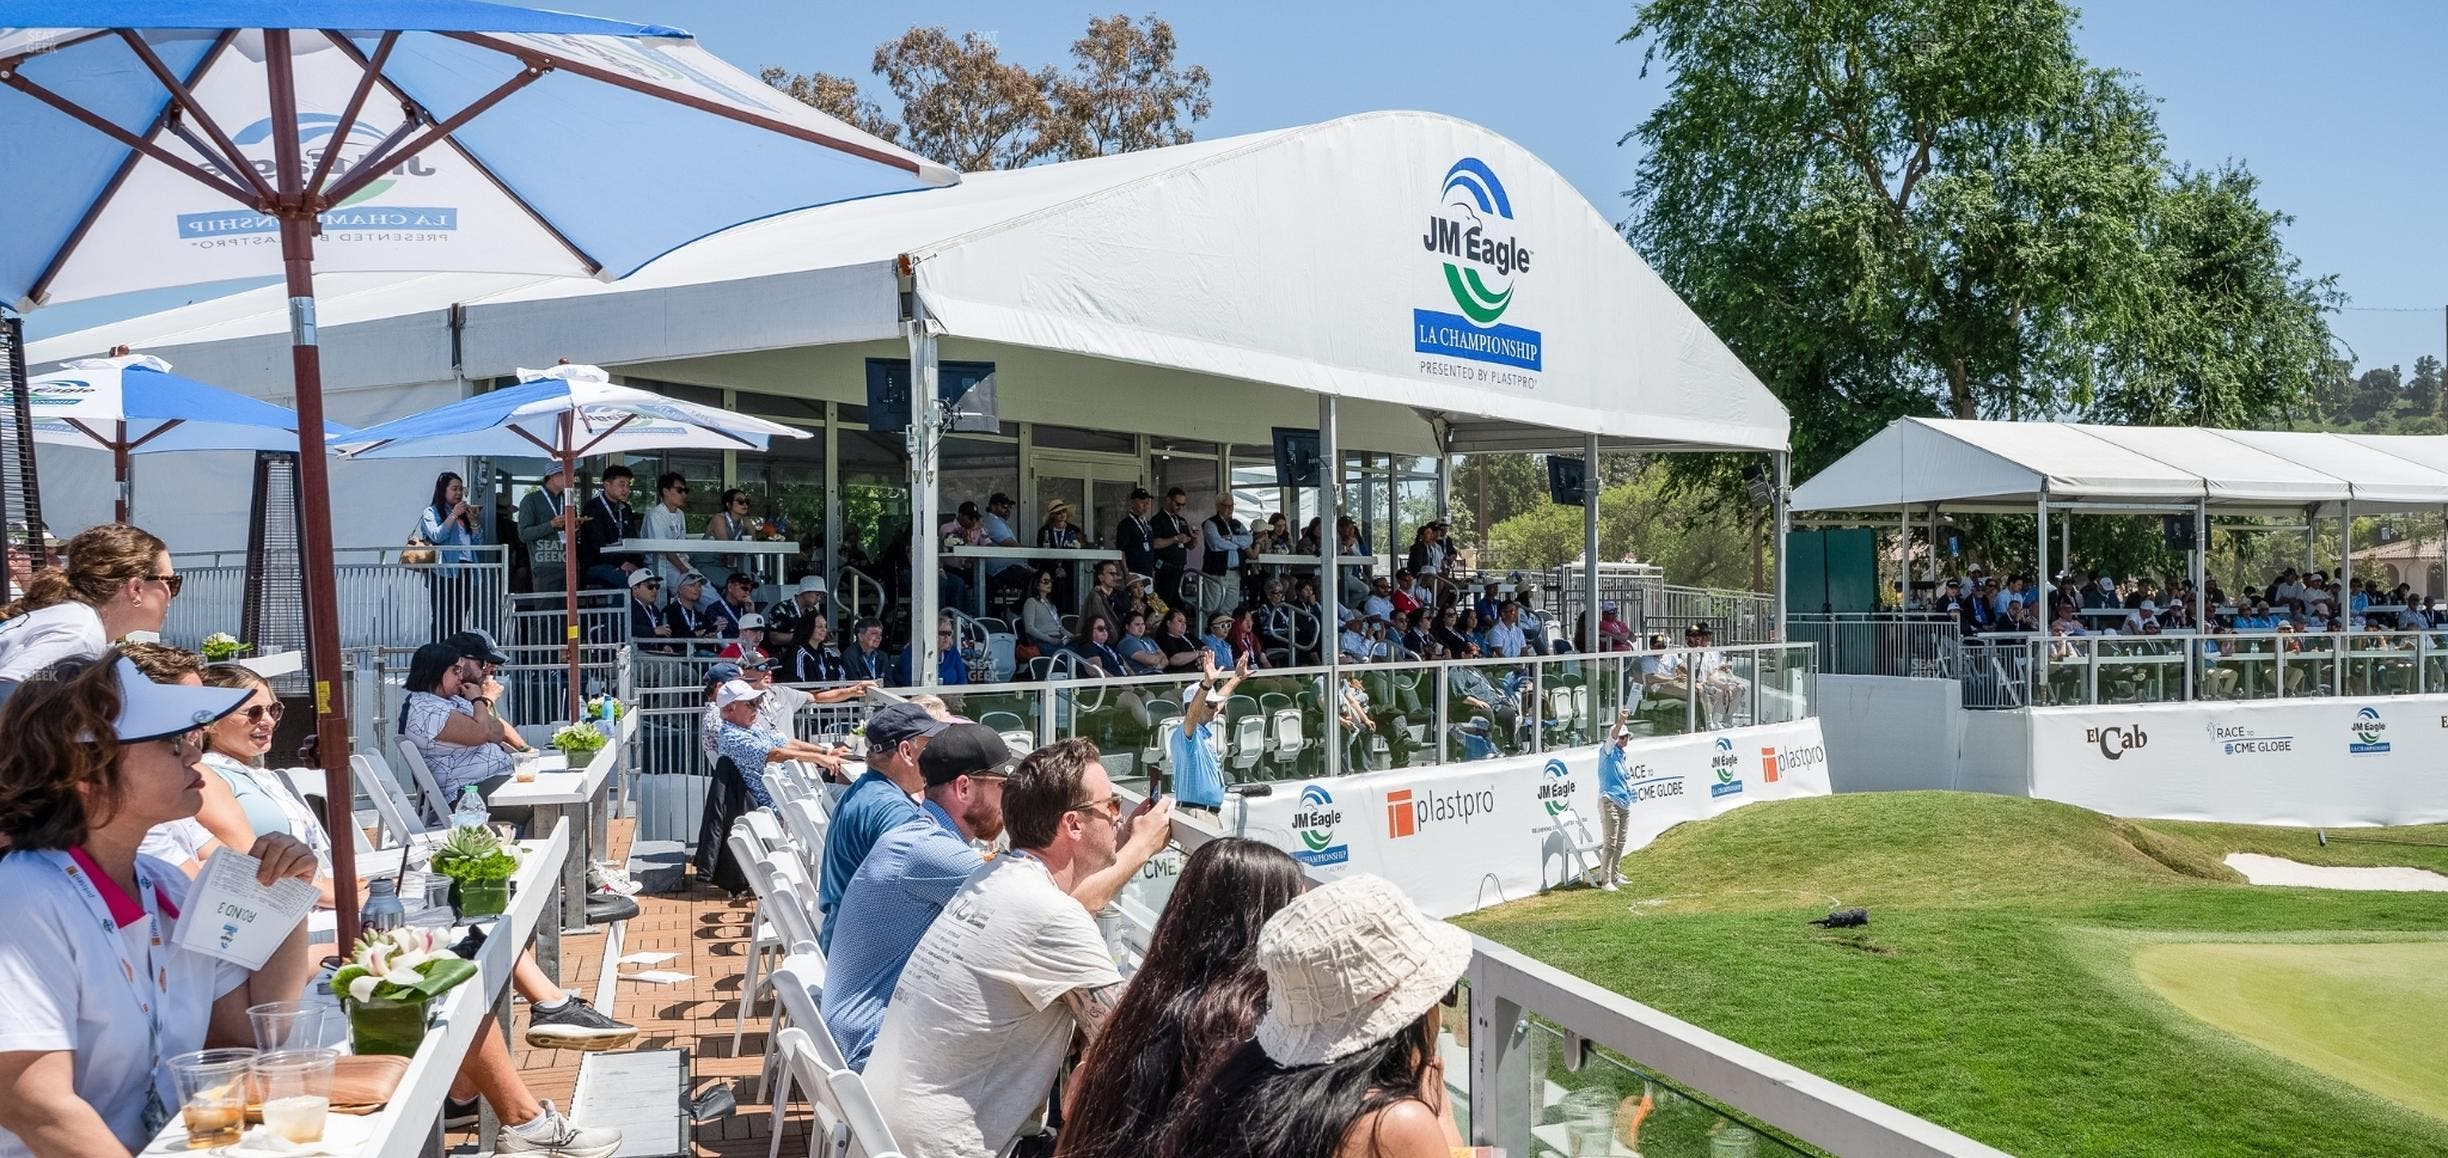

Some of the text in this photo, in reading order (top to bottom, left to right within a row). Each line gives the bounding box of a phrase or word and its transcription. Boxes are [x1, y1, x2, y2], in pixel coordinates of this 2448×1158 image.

[1423, 215, 1530, 276] JM Eagle
[1420, 324, 1538, 361] LA CHAMPIONSHIP
[1420, 360, 1475, 380] PRESENTED
[1478, 368, 1489, 381] BY
[2216, 726, 2245, 738] RACE
[2351, 721, 2386, 732] JM Eagle
[2086, 724, 2148, 760] El Cab
[2234, 741, 2291, 753] CME GLOBE
[1711, 754, 1737, 768] JM Eagle
[1778, 745, 1824, 778] plastpro
[1629, 764, 1646, 779] ACE
[1537, 780, 1576, 800] JM Eagle
[1638, 781, 1684, 801] CME GLOBE
[1291, 809, 1341, 829] JM Eagle
[1416, 789, 1494, 832] plastpro
[1143, 858, 1177, 879] CME
[217, 901, 226, 914] 3
